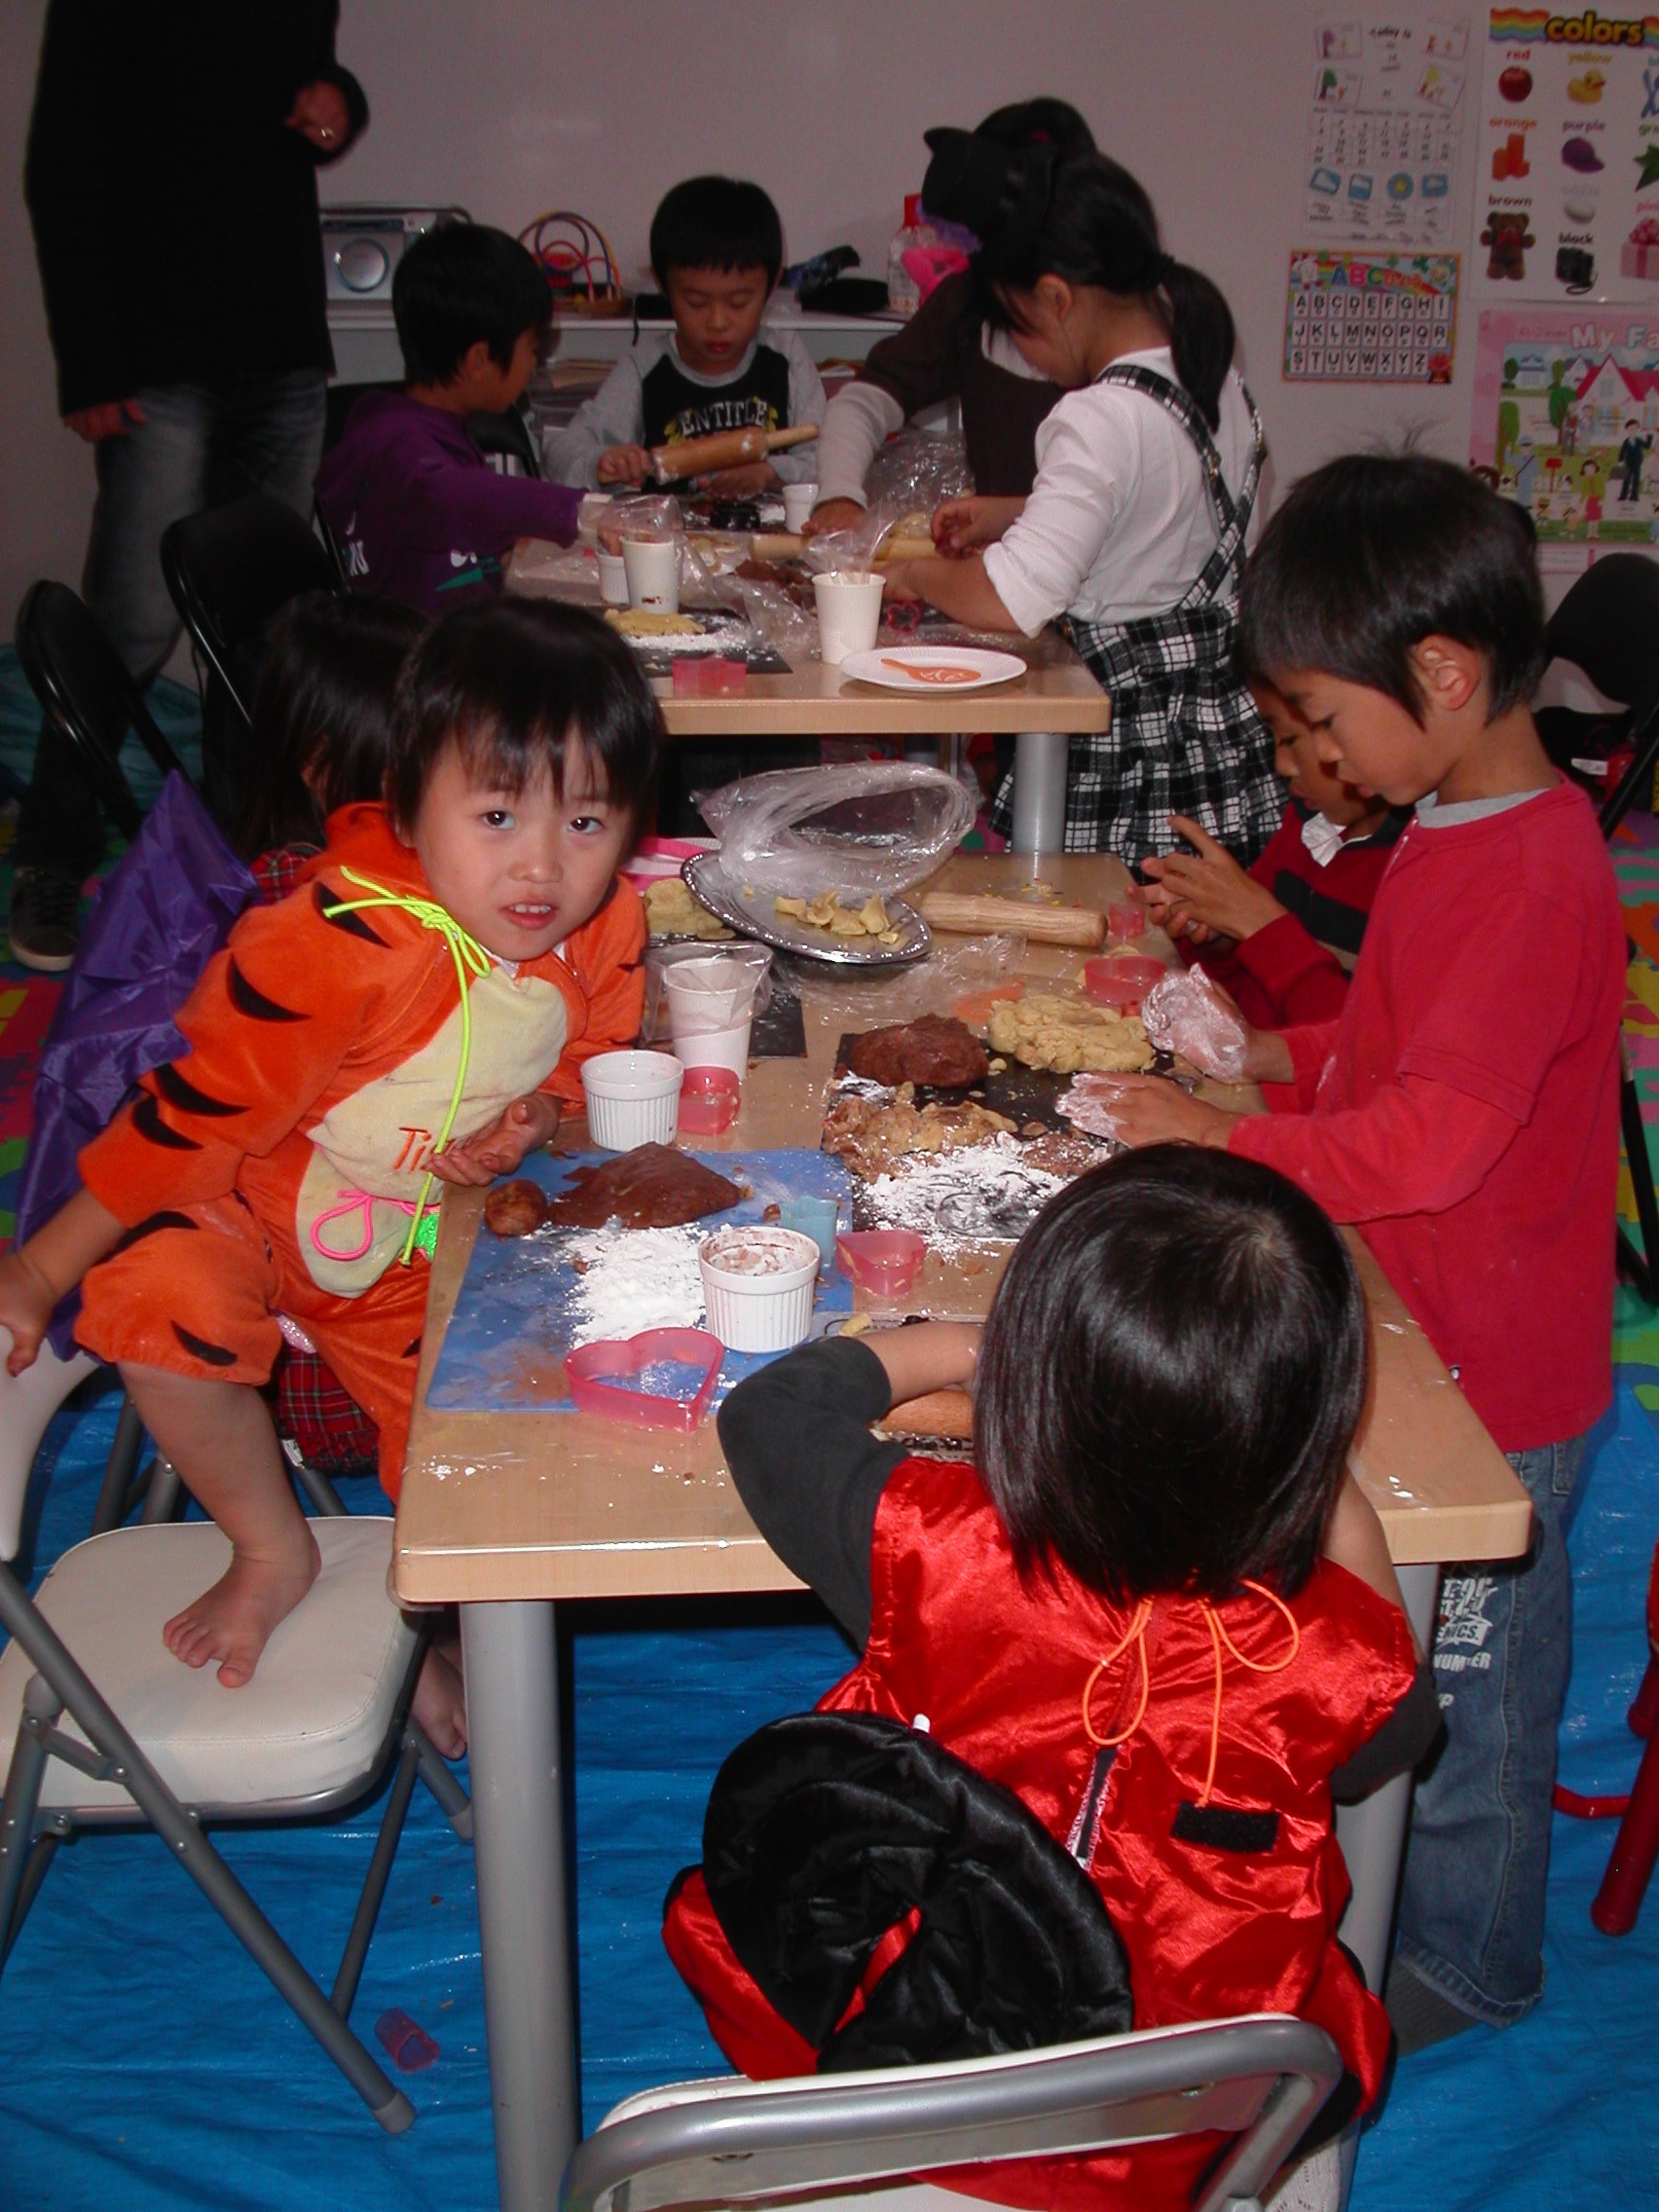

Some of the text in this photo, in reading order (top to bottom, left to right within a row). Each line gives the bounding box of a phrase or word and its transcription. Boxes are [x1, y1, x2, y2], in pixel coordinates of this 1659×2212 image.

[1546, 10, 1643, 46] colors
[1506, 49, 1530, 60] red
[1568, 50, 1612, 65] yellow
[1489, 117, 1537, 130] orange
[1563, 120, 1605, 133] purple
[1489, 195, 1532, 206] brown
[1559, 232, 1593, 243] black
[1571, 322, 1615, 352] My
[680, 398, 767, 436] ENTITLE
